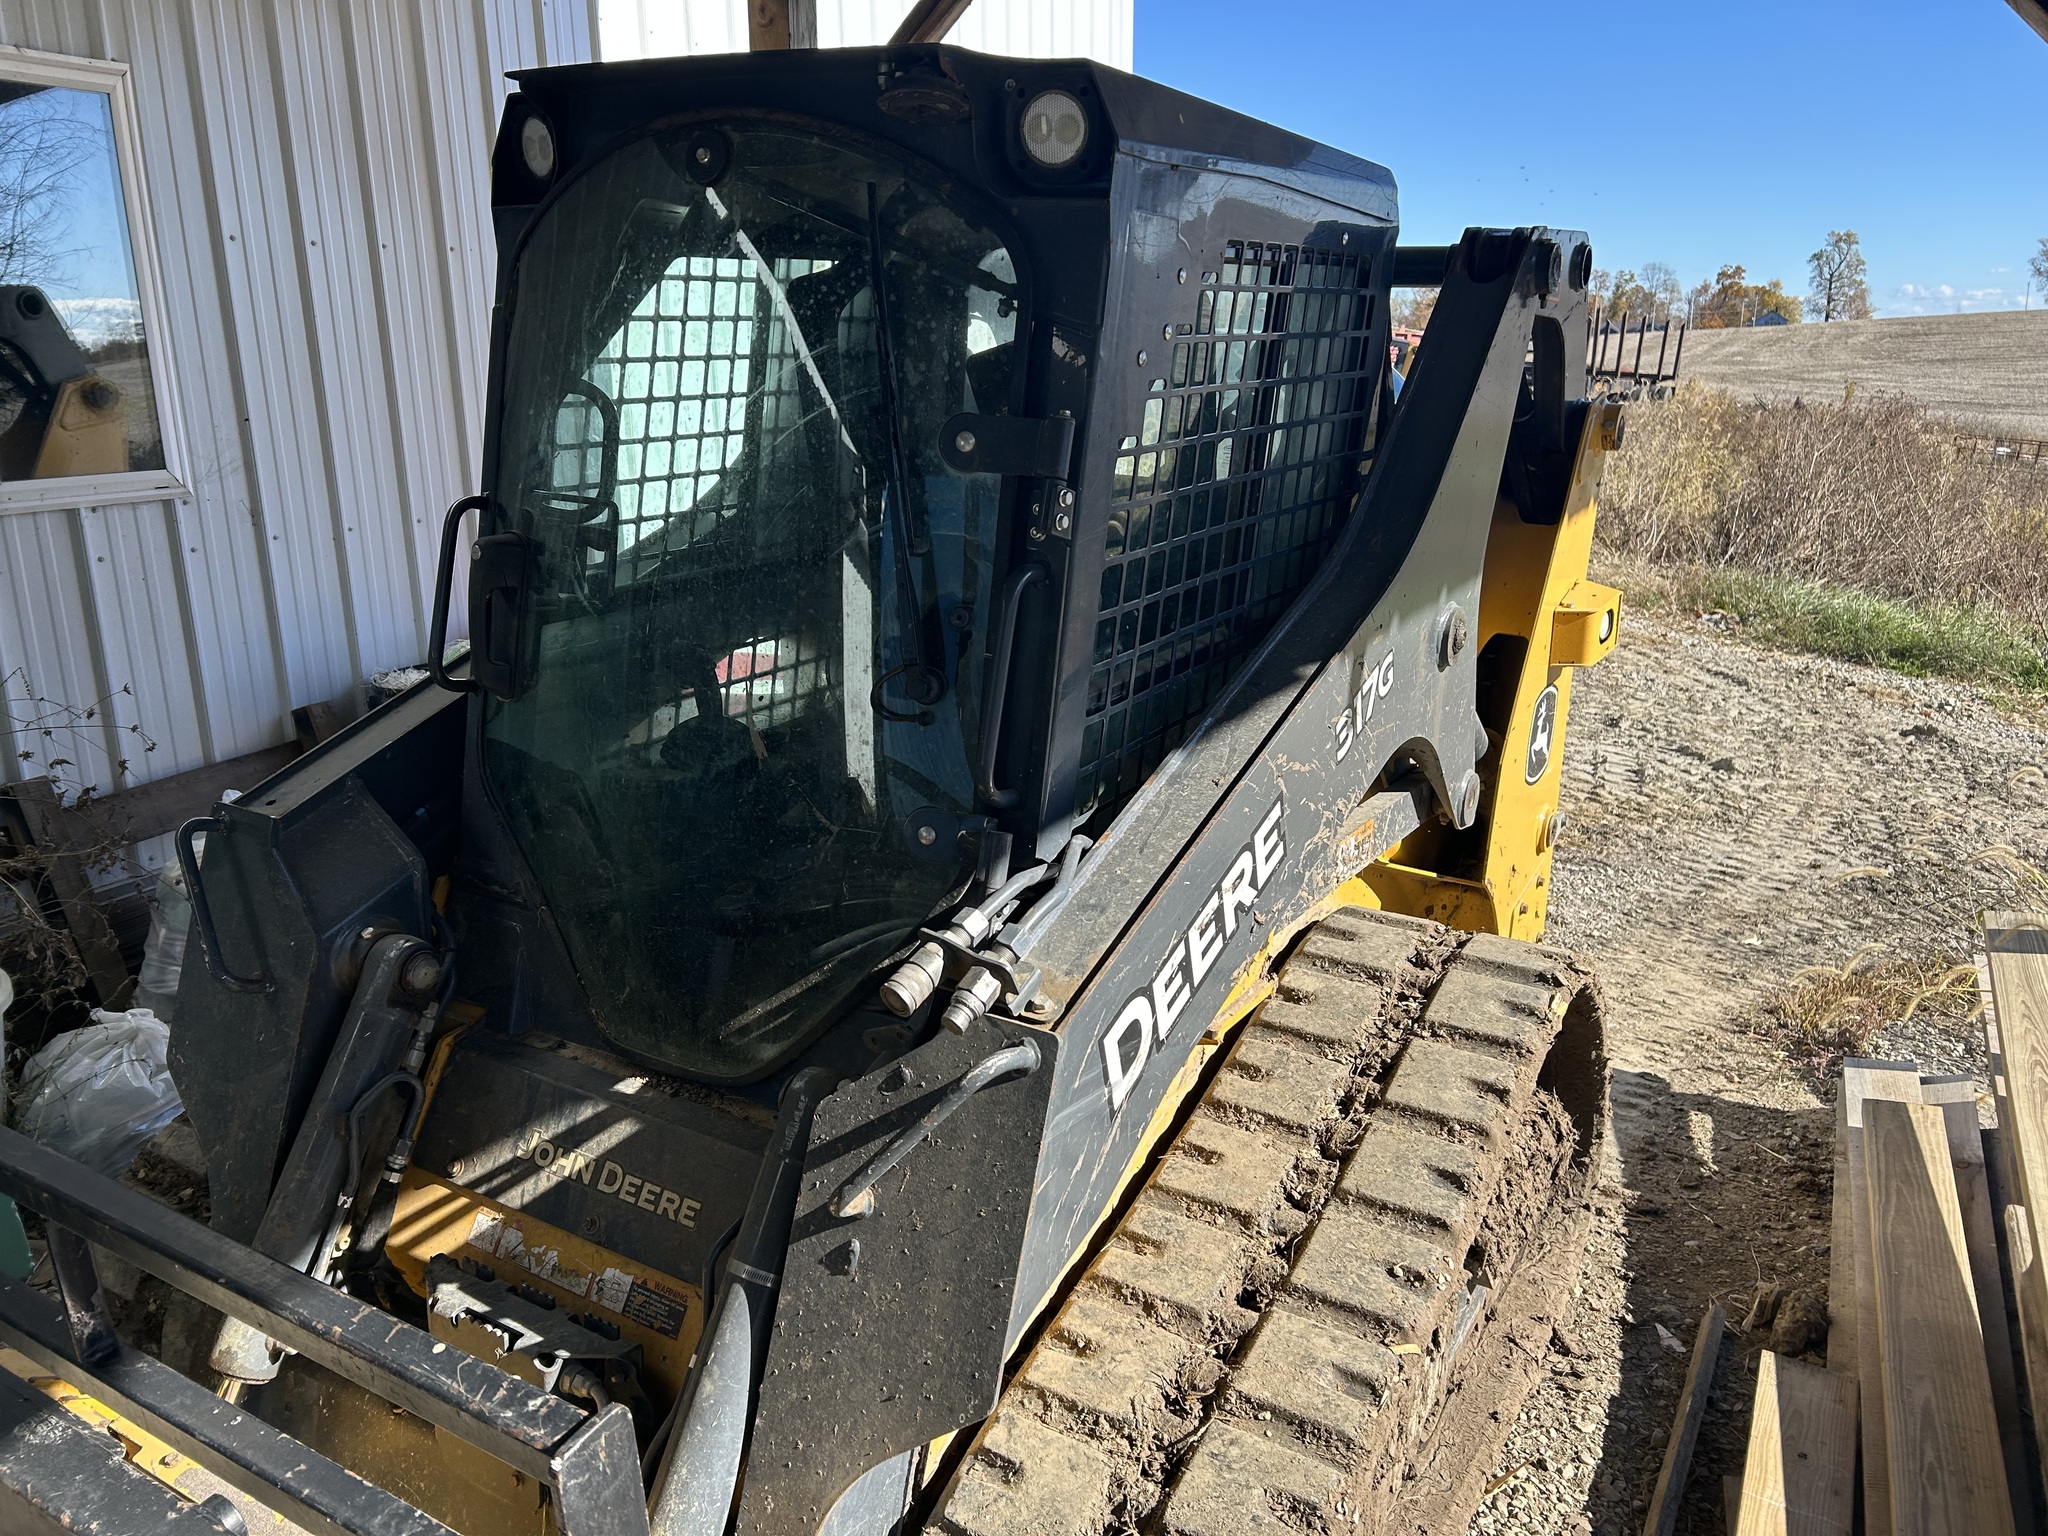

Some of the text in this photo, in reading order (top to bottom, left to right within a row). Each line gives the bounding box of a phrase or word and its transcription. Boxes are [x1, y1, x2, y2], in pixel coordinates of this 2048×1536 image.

[1335, 651, 1394, 762] 317G
[1103, 800, 1284, 1111] DEERE
[516, 1129, 702, 1229] JOHN DEERE
[654, 1281, 689, 1304] WARNING
